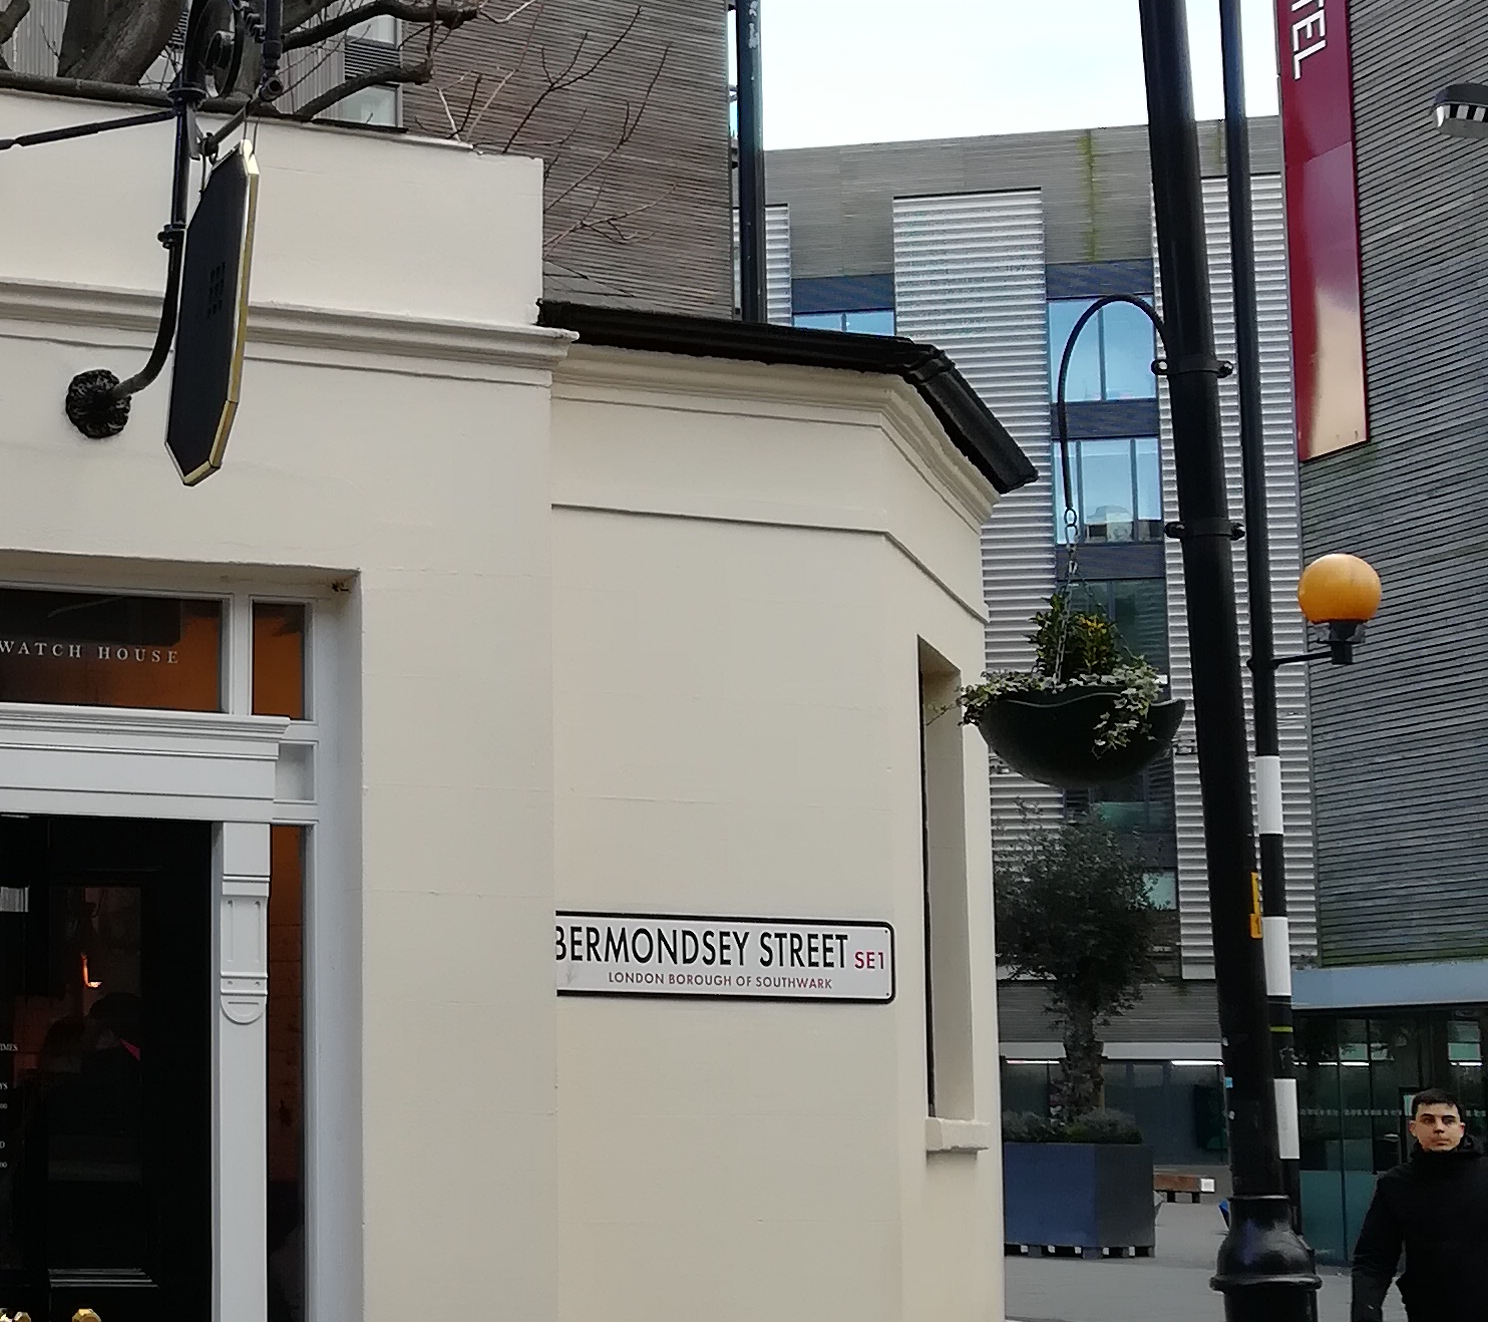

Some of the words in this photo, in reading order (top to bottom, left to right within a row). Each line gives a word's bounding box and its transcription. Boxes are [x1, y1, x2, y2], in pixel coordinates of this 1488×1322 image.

[98, 645, 179, 664] HOUSE
[556, 925, 750, 966] BERMONDSEY
[759, 931, 849, 969] STREET
[854, 951, 885, 969] SE1
[608, 971, 664, 984] LONDON
[668, 973, 732, 986] BOROUGH
[736, 975, 752, 987] OF
[755, 976, 833, 989] SOUTHWARK
